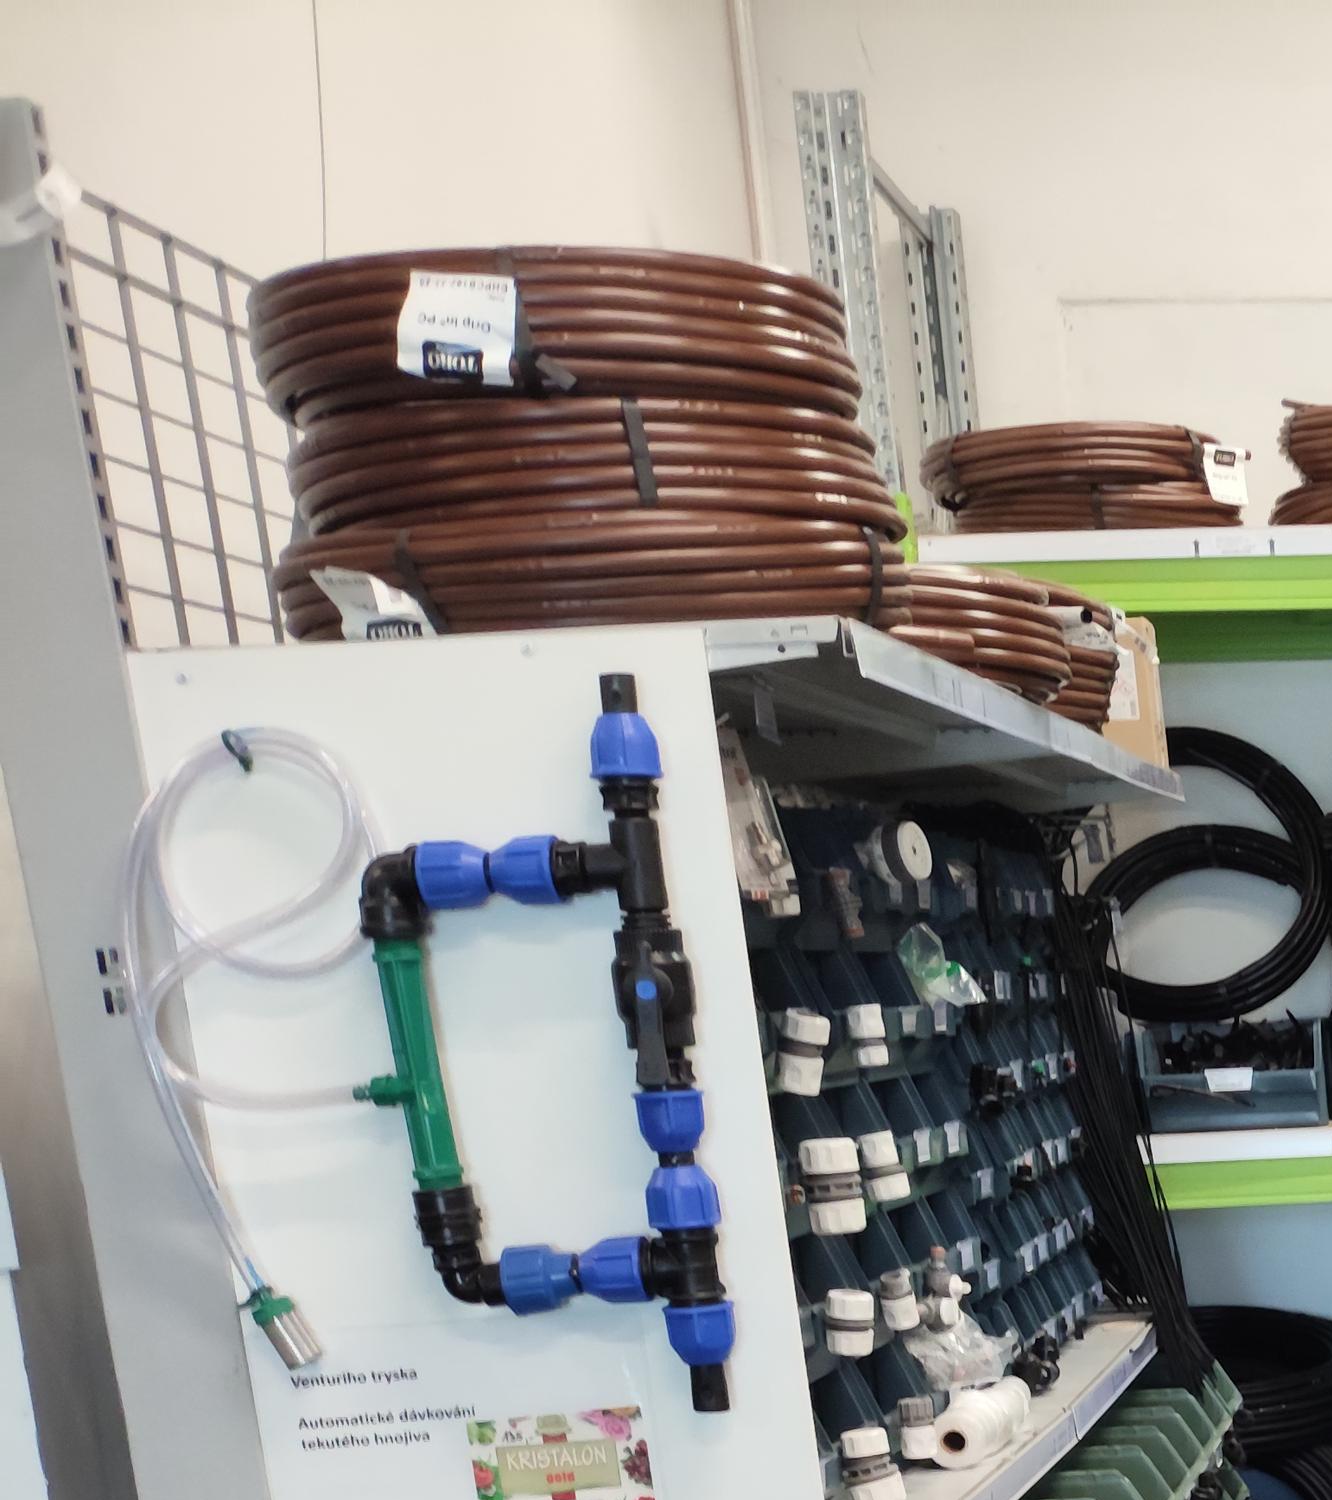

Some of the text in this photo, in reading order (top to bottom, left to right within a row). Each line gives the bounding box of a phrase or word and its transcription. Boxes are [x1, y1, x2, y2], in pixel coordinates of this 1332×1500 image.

[290, 1368, 418, 1390] Venturiho tryska
[298, 1405, 476, 1431] Automatické dávkování
[301, 1430, 431, 1451] tekutého hnojiva
[506, 1446, 608, 1471] KRISTALON
